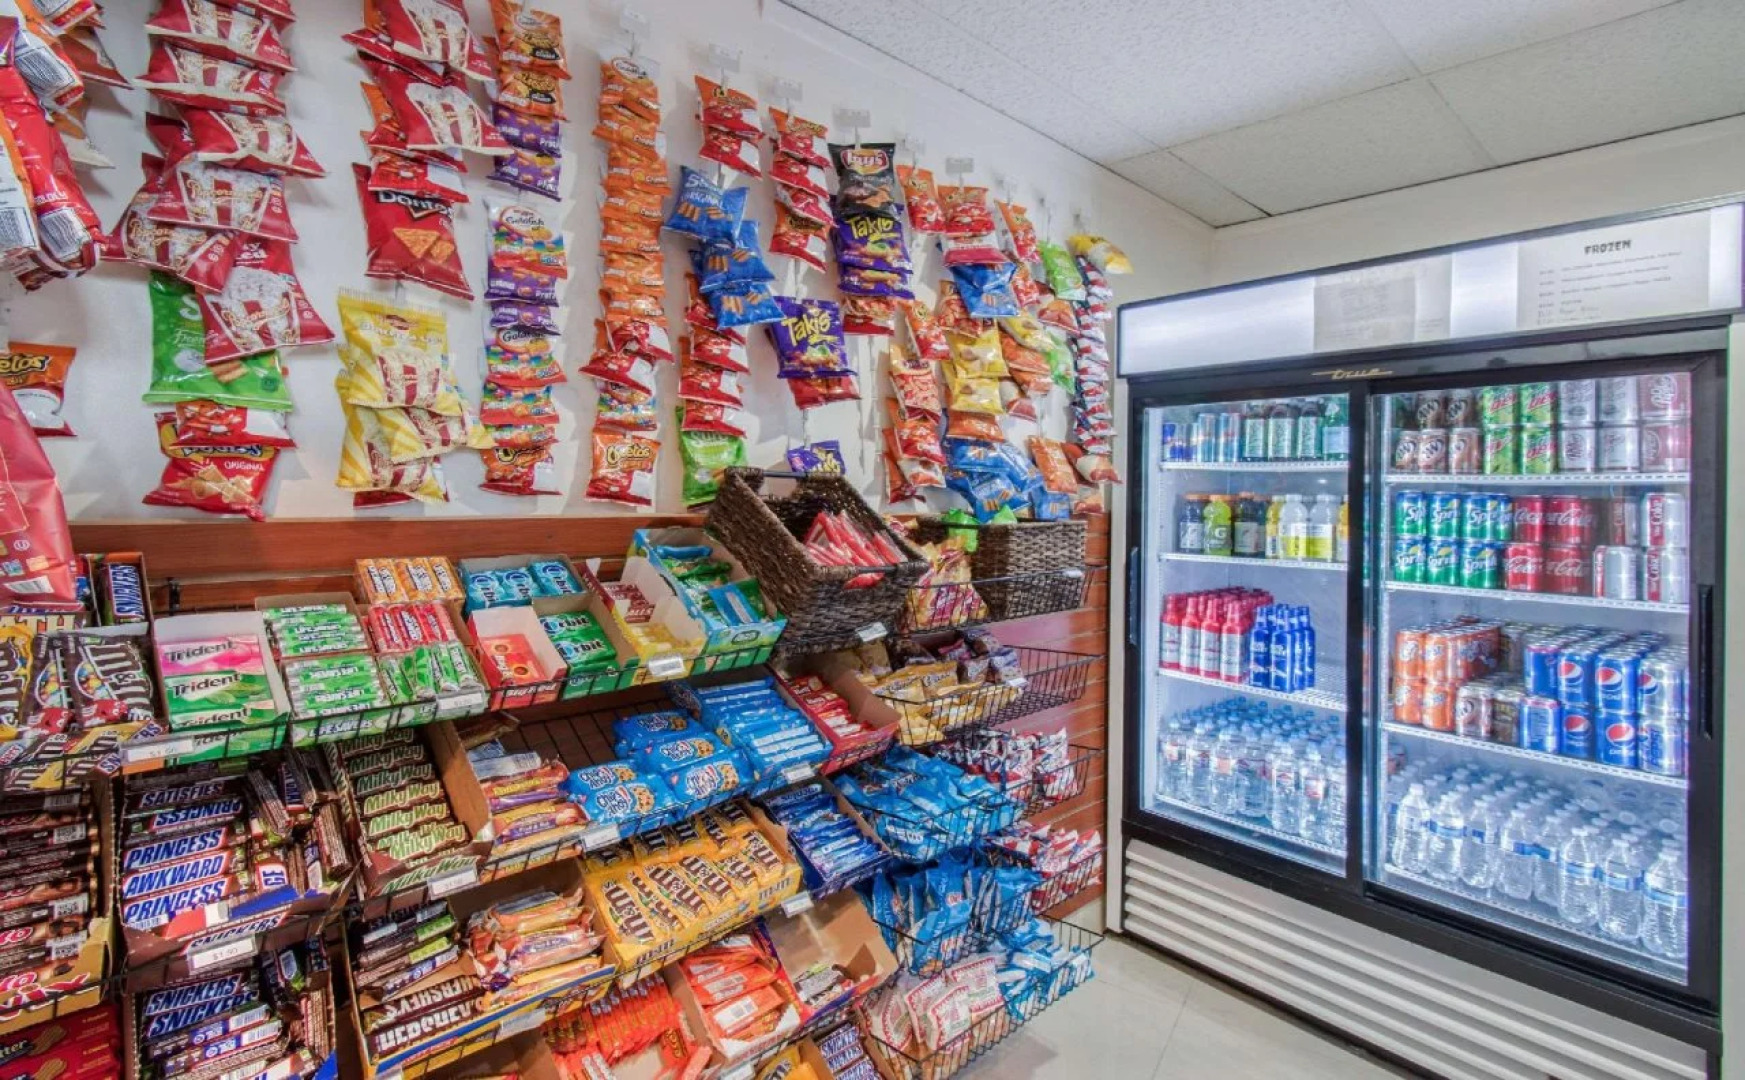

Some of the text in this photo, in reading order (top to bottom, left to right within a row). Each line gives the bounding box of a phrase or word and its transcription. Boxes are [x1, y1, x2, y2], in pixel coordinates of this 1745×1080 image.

[1584, 239, 1632, 255] FROZEN
[782, 313, 831, 347] Takis
[164, 641, 235, 664] Trident
[172, 673, 240, 698] Trident
[350, 744, 424, 774] Milky Way
[140, 782, 225, 808] SATISFIES
[358, 763, 432, 794] Milky Way
[365, 781, 440, 814] Milky Way
[154, 802, 243, 828] PRINCESS
[370, 802, 447, 835] Milky Way
[126, 829, 223, 871] PRINCESS
[390, 824, 466, 859] Milky Way
[125, 853, 227, 899] AWKWARD
[125, 880, 226, 925] PRINCESS
[149, 974, 240, 1014] SNICKERS
